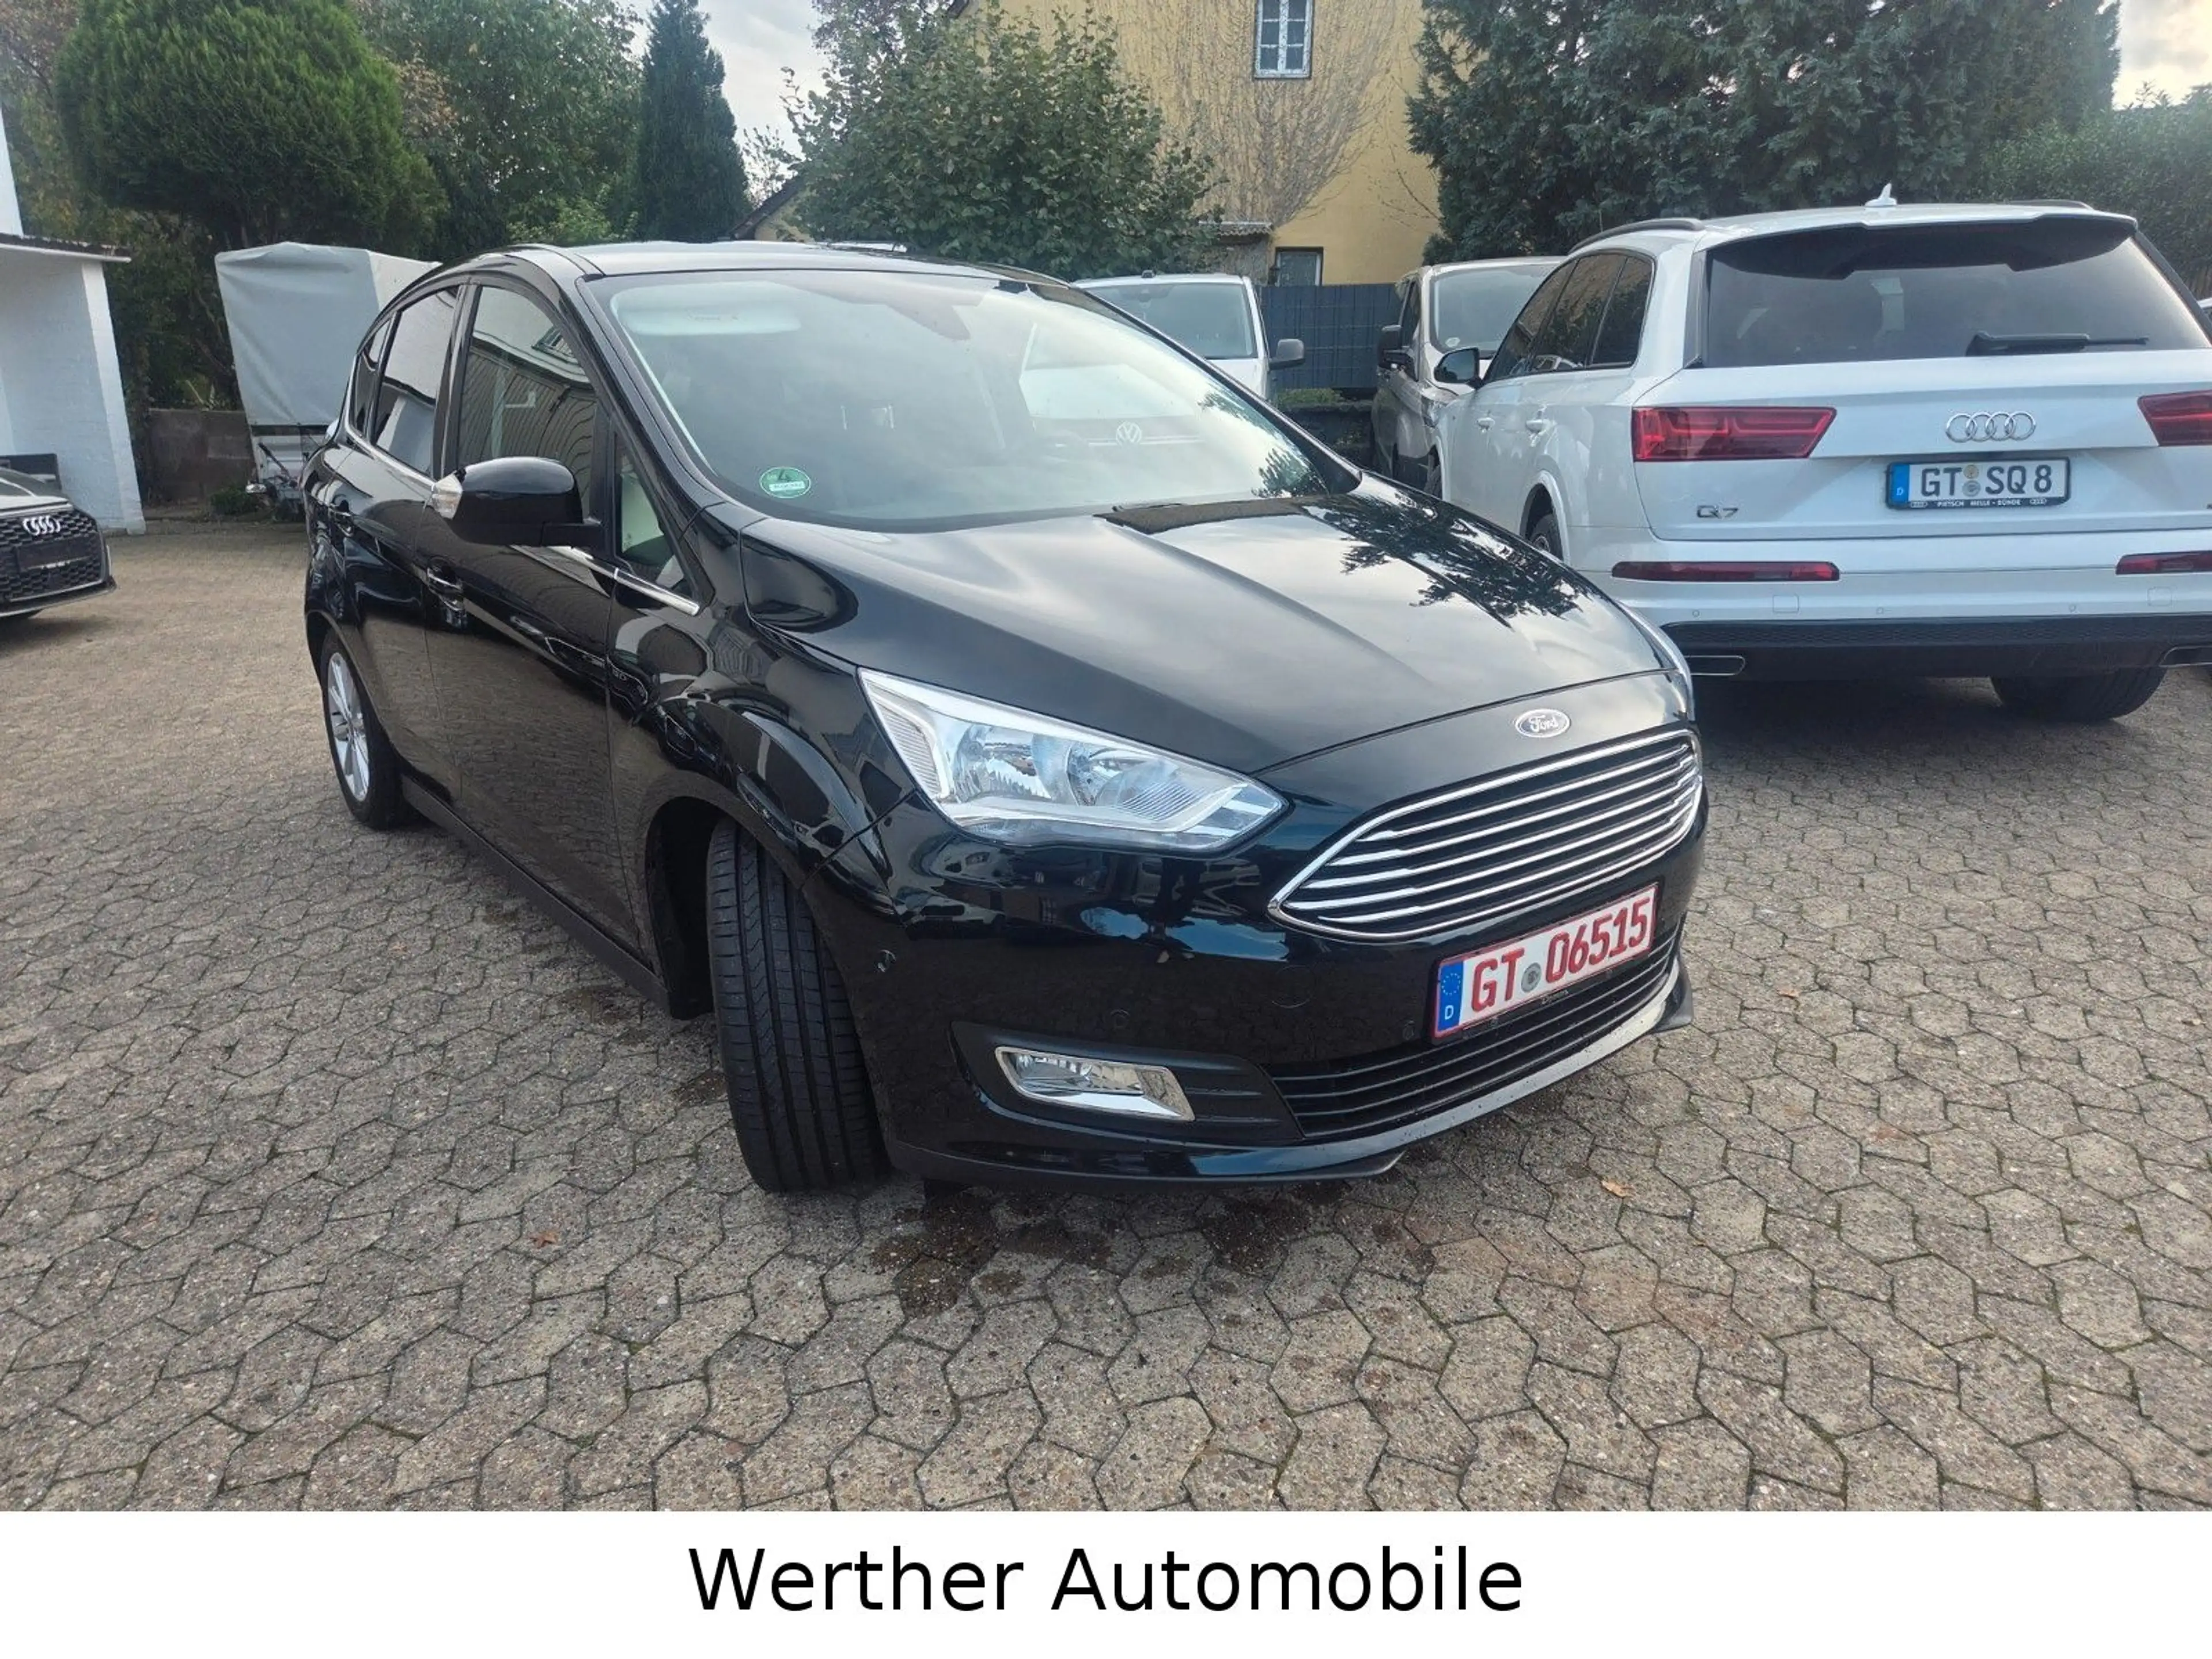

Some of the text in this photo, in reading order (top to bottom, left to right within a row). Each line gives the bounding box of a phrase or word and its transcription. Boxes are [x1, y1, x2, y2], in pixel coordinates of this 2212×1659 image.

[1896, 464, 2052, 496] D GT SQ 8
[1696, 505, 1738, 519] Q7
[1529, 715, 1559, 732] Ford
[1444, 896, 1650, 1020] D GT 06515
